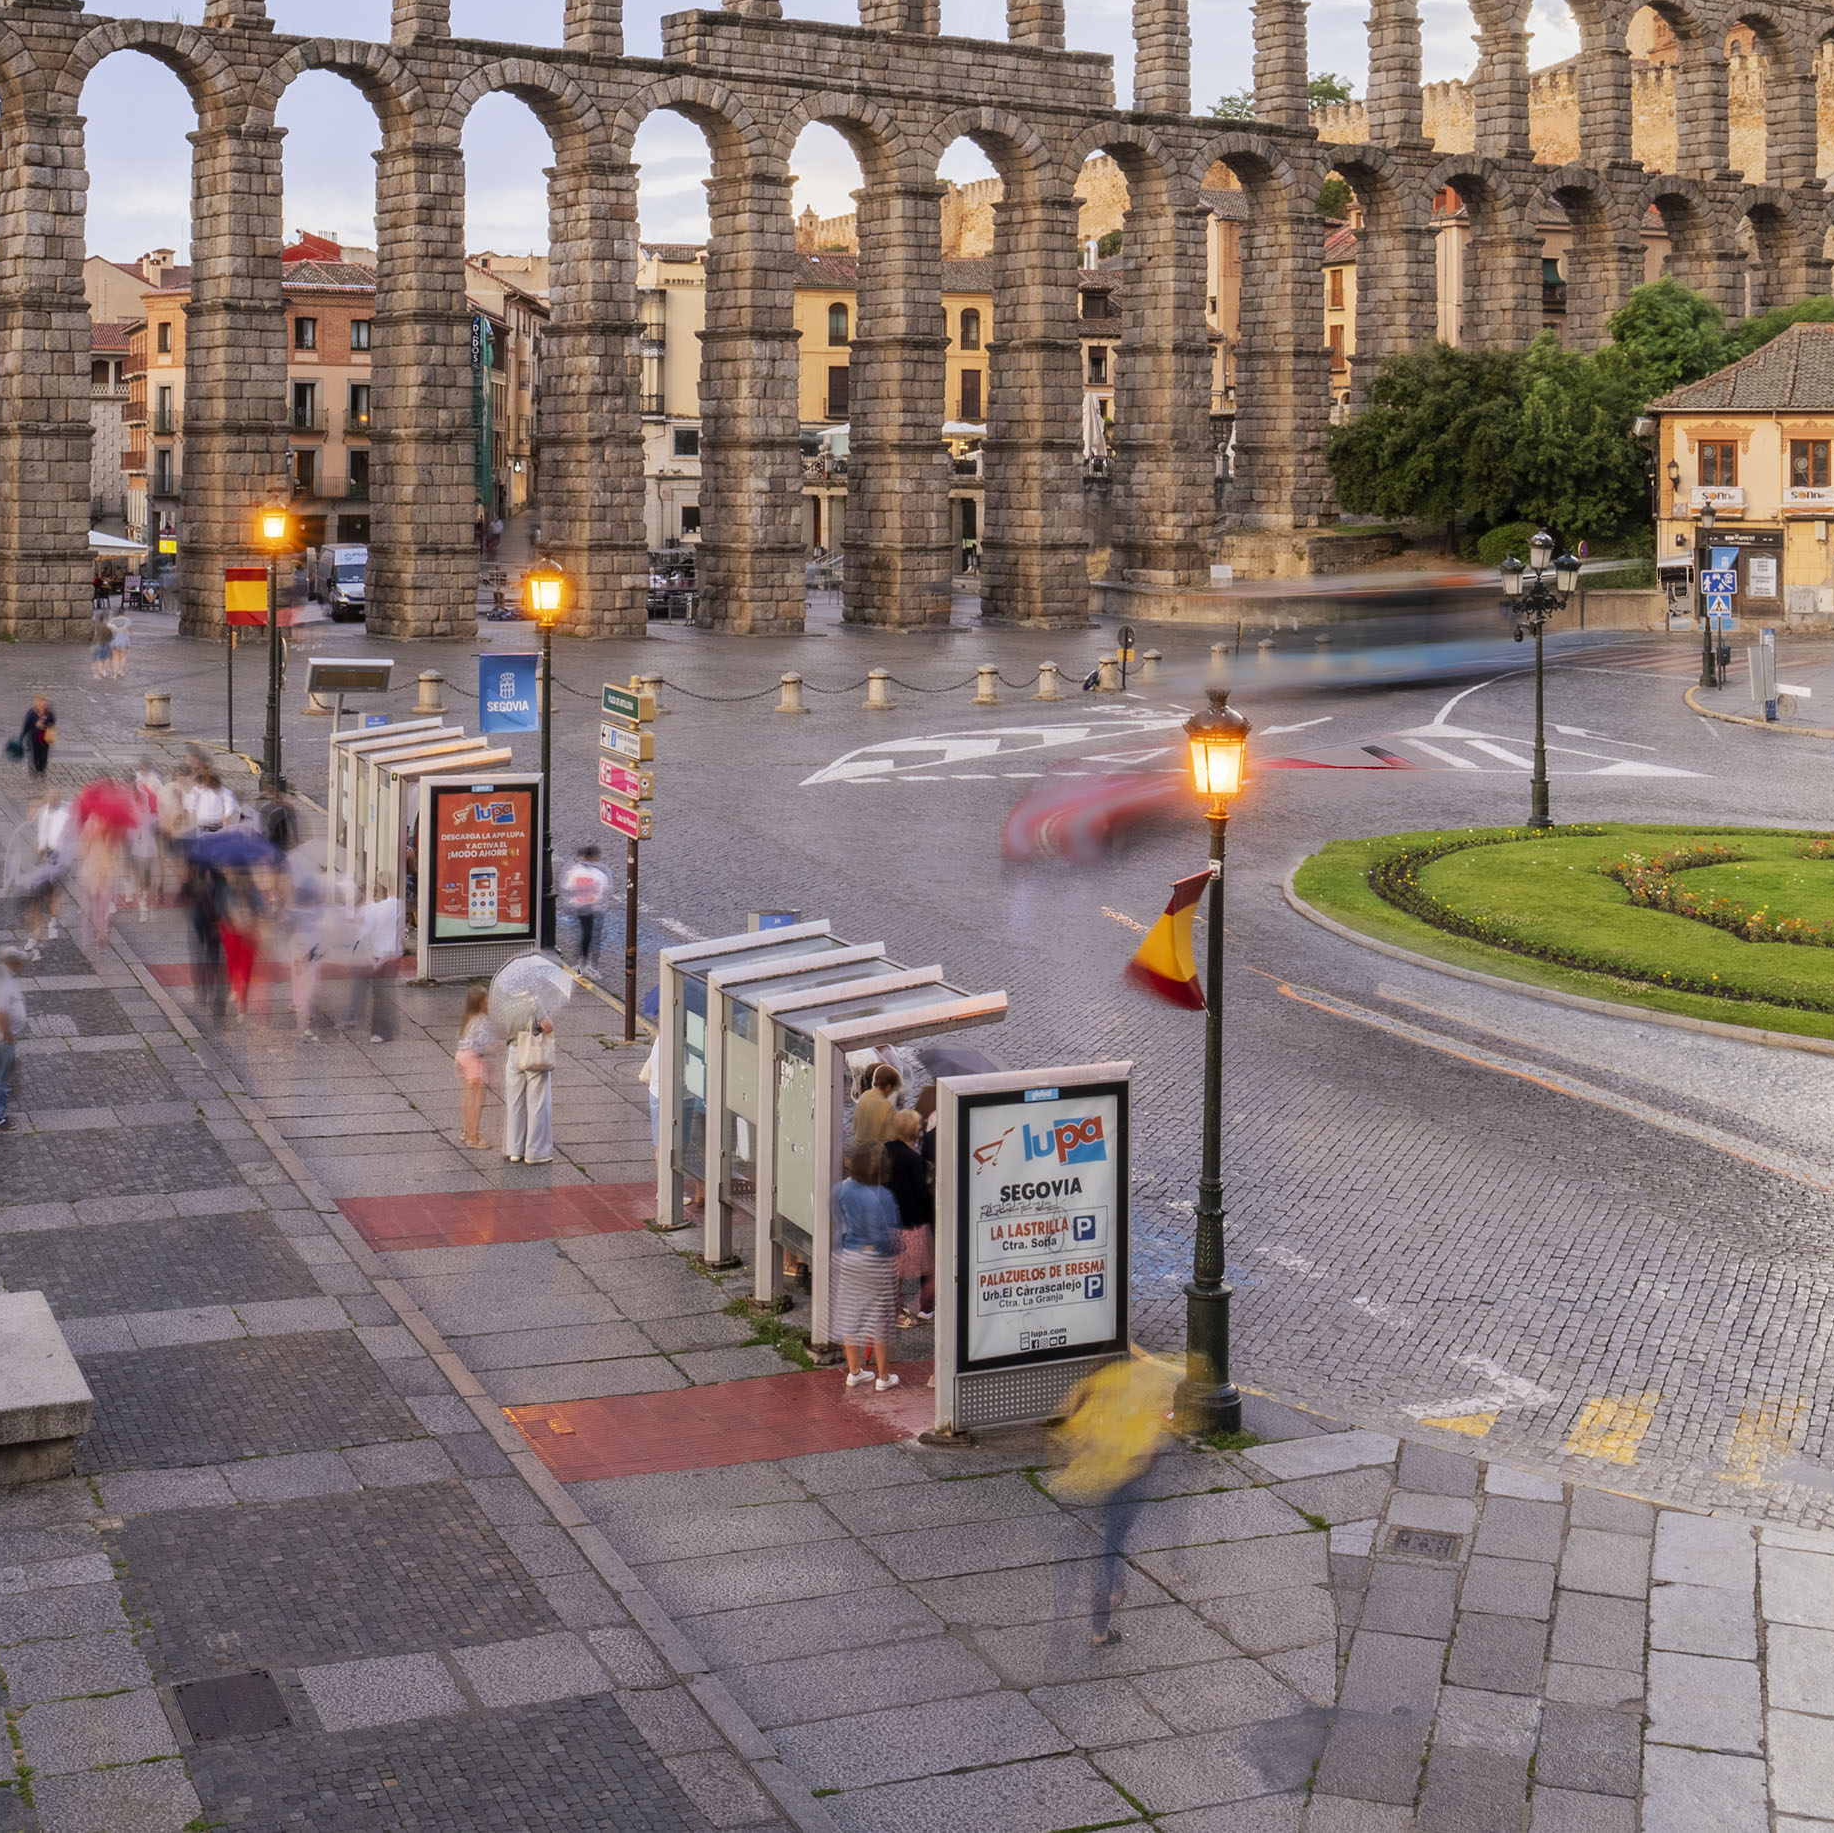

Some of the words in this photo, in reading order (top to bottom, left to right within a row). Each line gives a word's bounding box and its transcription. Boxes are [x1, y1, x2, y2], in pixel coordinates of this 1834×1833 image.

[487, 700, 529, 712] SEGOVIA
[474, 802, 513, 822] lupa
[441, 833, 481, 842] DESCARGA
[448, 850, 478, 860] ¡MODO
[1022, 1115, 1105, 1166] lupa
[1000, 1177, 1082, 1204] SEGOVIA
[990, 1226, 1004, 1241] LA
[1007, 1216, 1069, 1238] LASTRILLA
[1002, 1239, 1028, 1252] Ctra.
[979, 1267, 1047, 1288] PALAZUELOS
[1049, 1264, 1062, 1278] DE
[1066, 1258, 1105, 1276] ERESMA
[1016, 1280, 1082, 1298] Carrascalejo
[999, 1298, 1020, 1308] Ctra.
[1023, 1296, 1034, 1306] La
[1036, 1292, 1064, 1306] Granja
[1030, 1326, 1067, 1339] lupa.com
